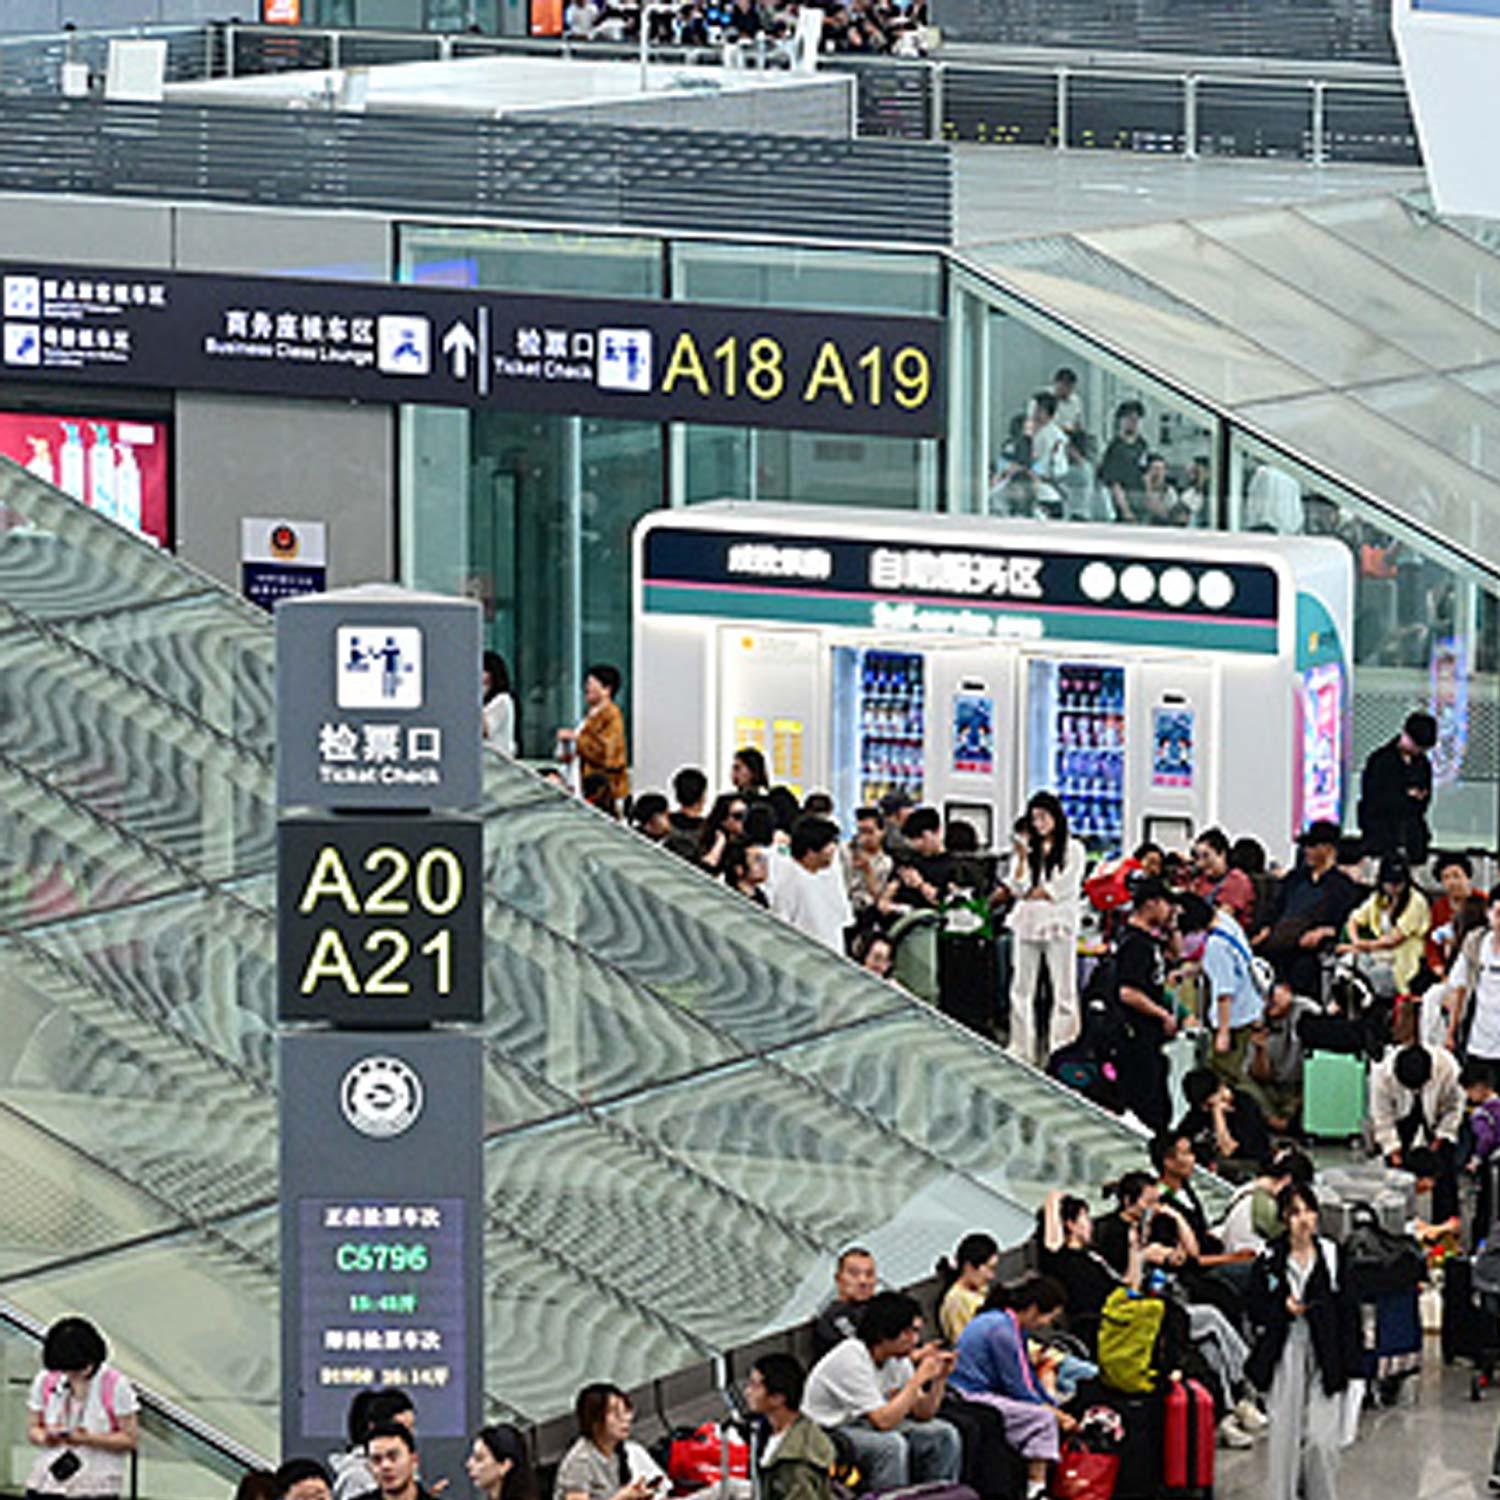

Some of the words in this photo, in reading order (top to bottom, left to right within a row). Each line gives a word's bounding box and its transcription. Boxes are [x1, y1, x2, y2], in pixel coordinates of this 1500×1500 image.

[517, 327, 594, 358] 检票口
[662, 332, 783, 400] A18
[804, 341, 929, 409] A19
[319, 722, 441, 763] 检票口
[319, 766, 378, 784] Ticket
[299, 847, 463, 915] A20
[300, 928, 451, 994] A21
